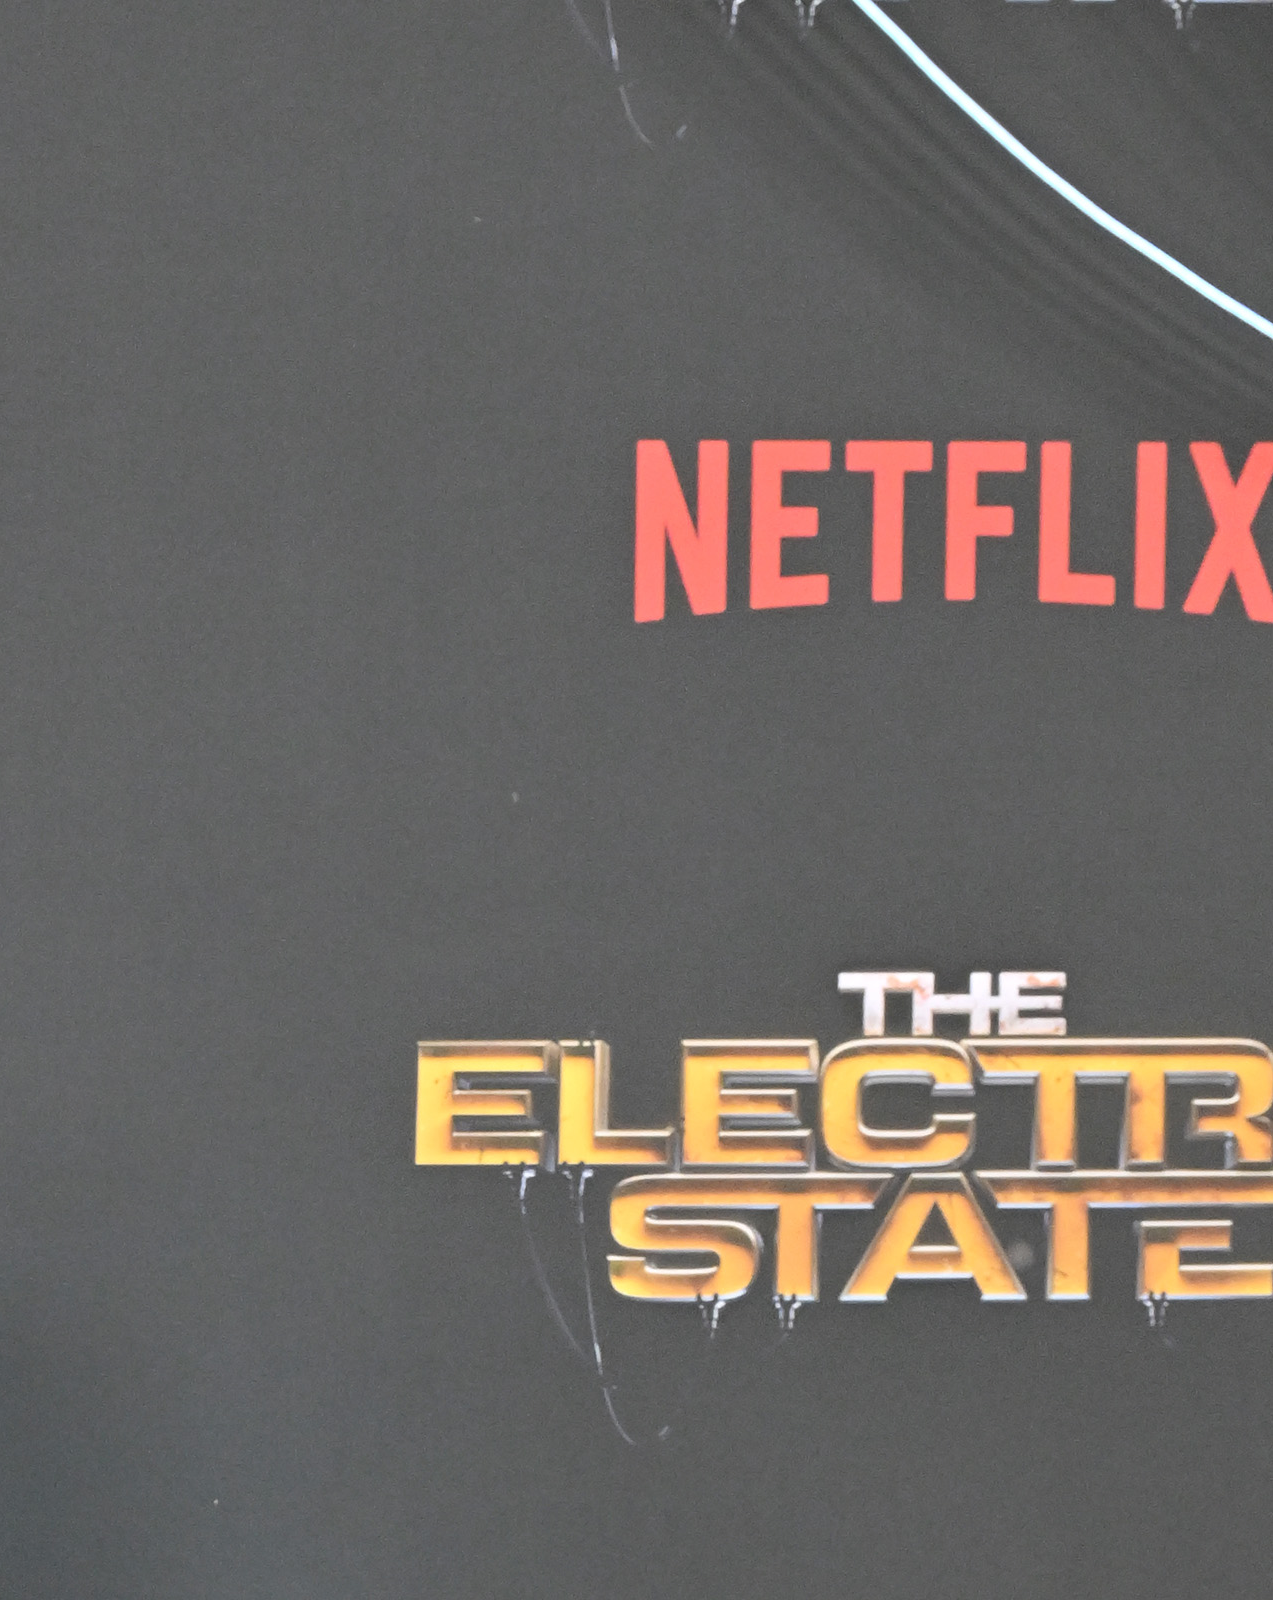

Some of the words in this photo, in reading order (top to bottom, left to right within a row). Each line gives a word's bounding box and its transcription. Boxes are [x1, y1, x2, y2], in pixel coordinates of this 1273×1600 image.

[634, 439, 1273, 624] NETFLIX
[838, 970, 1067, 1036] THE
[607, 1169, 1273, 1303] STATE
